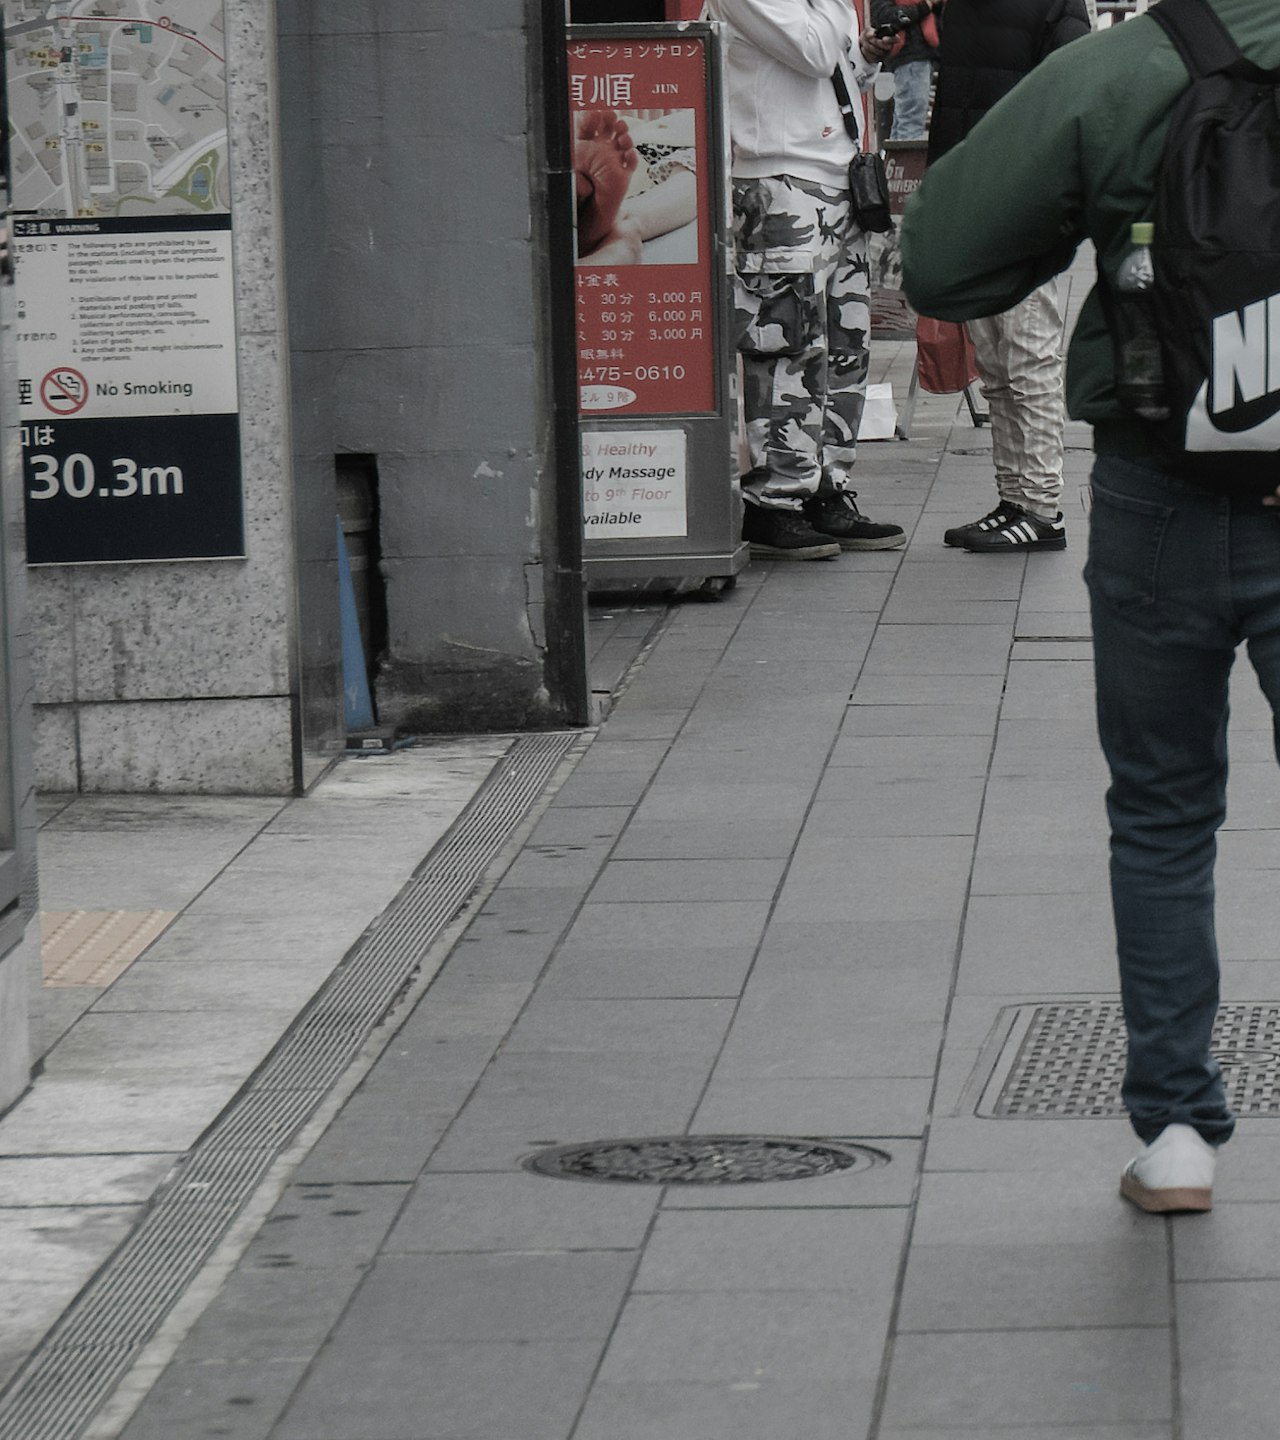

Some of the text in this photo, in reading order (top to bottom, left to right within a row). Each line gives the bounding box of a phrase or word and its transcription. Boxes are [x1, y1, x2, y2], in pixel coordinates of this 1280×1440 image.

[567, 44, 699, 59] ゼーションサロン
[651, 83, 679, 94] JUN
[55, 223, 100, 233] WARNING
[580, 365, 685, 382] 475-0610
[96, 380, 193, 397] No Smoking
[598, 442, 658, 457] Healthy
[29, 453, 184, 500] 30.3m
[582, 466, 676, 483] dy Massage
[585, 487, 672, 502] to 9th Floor
